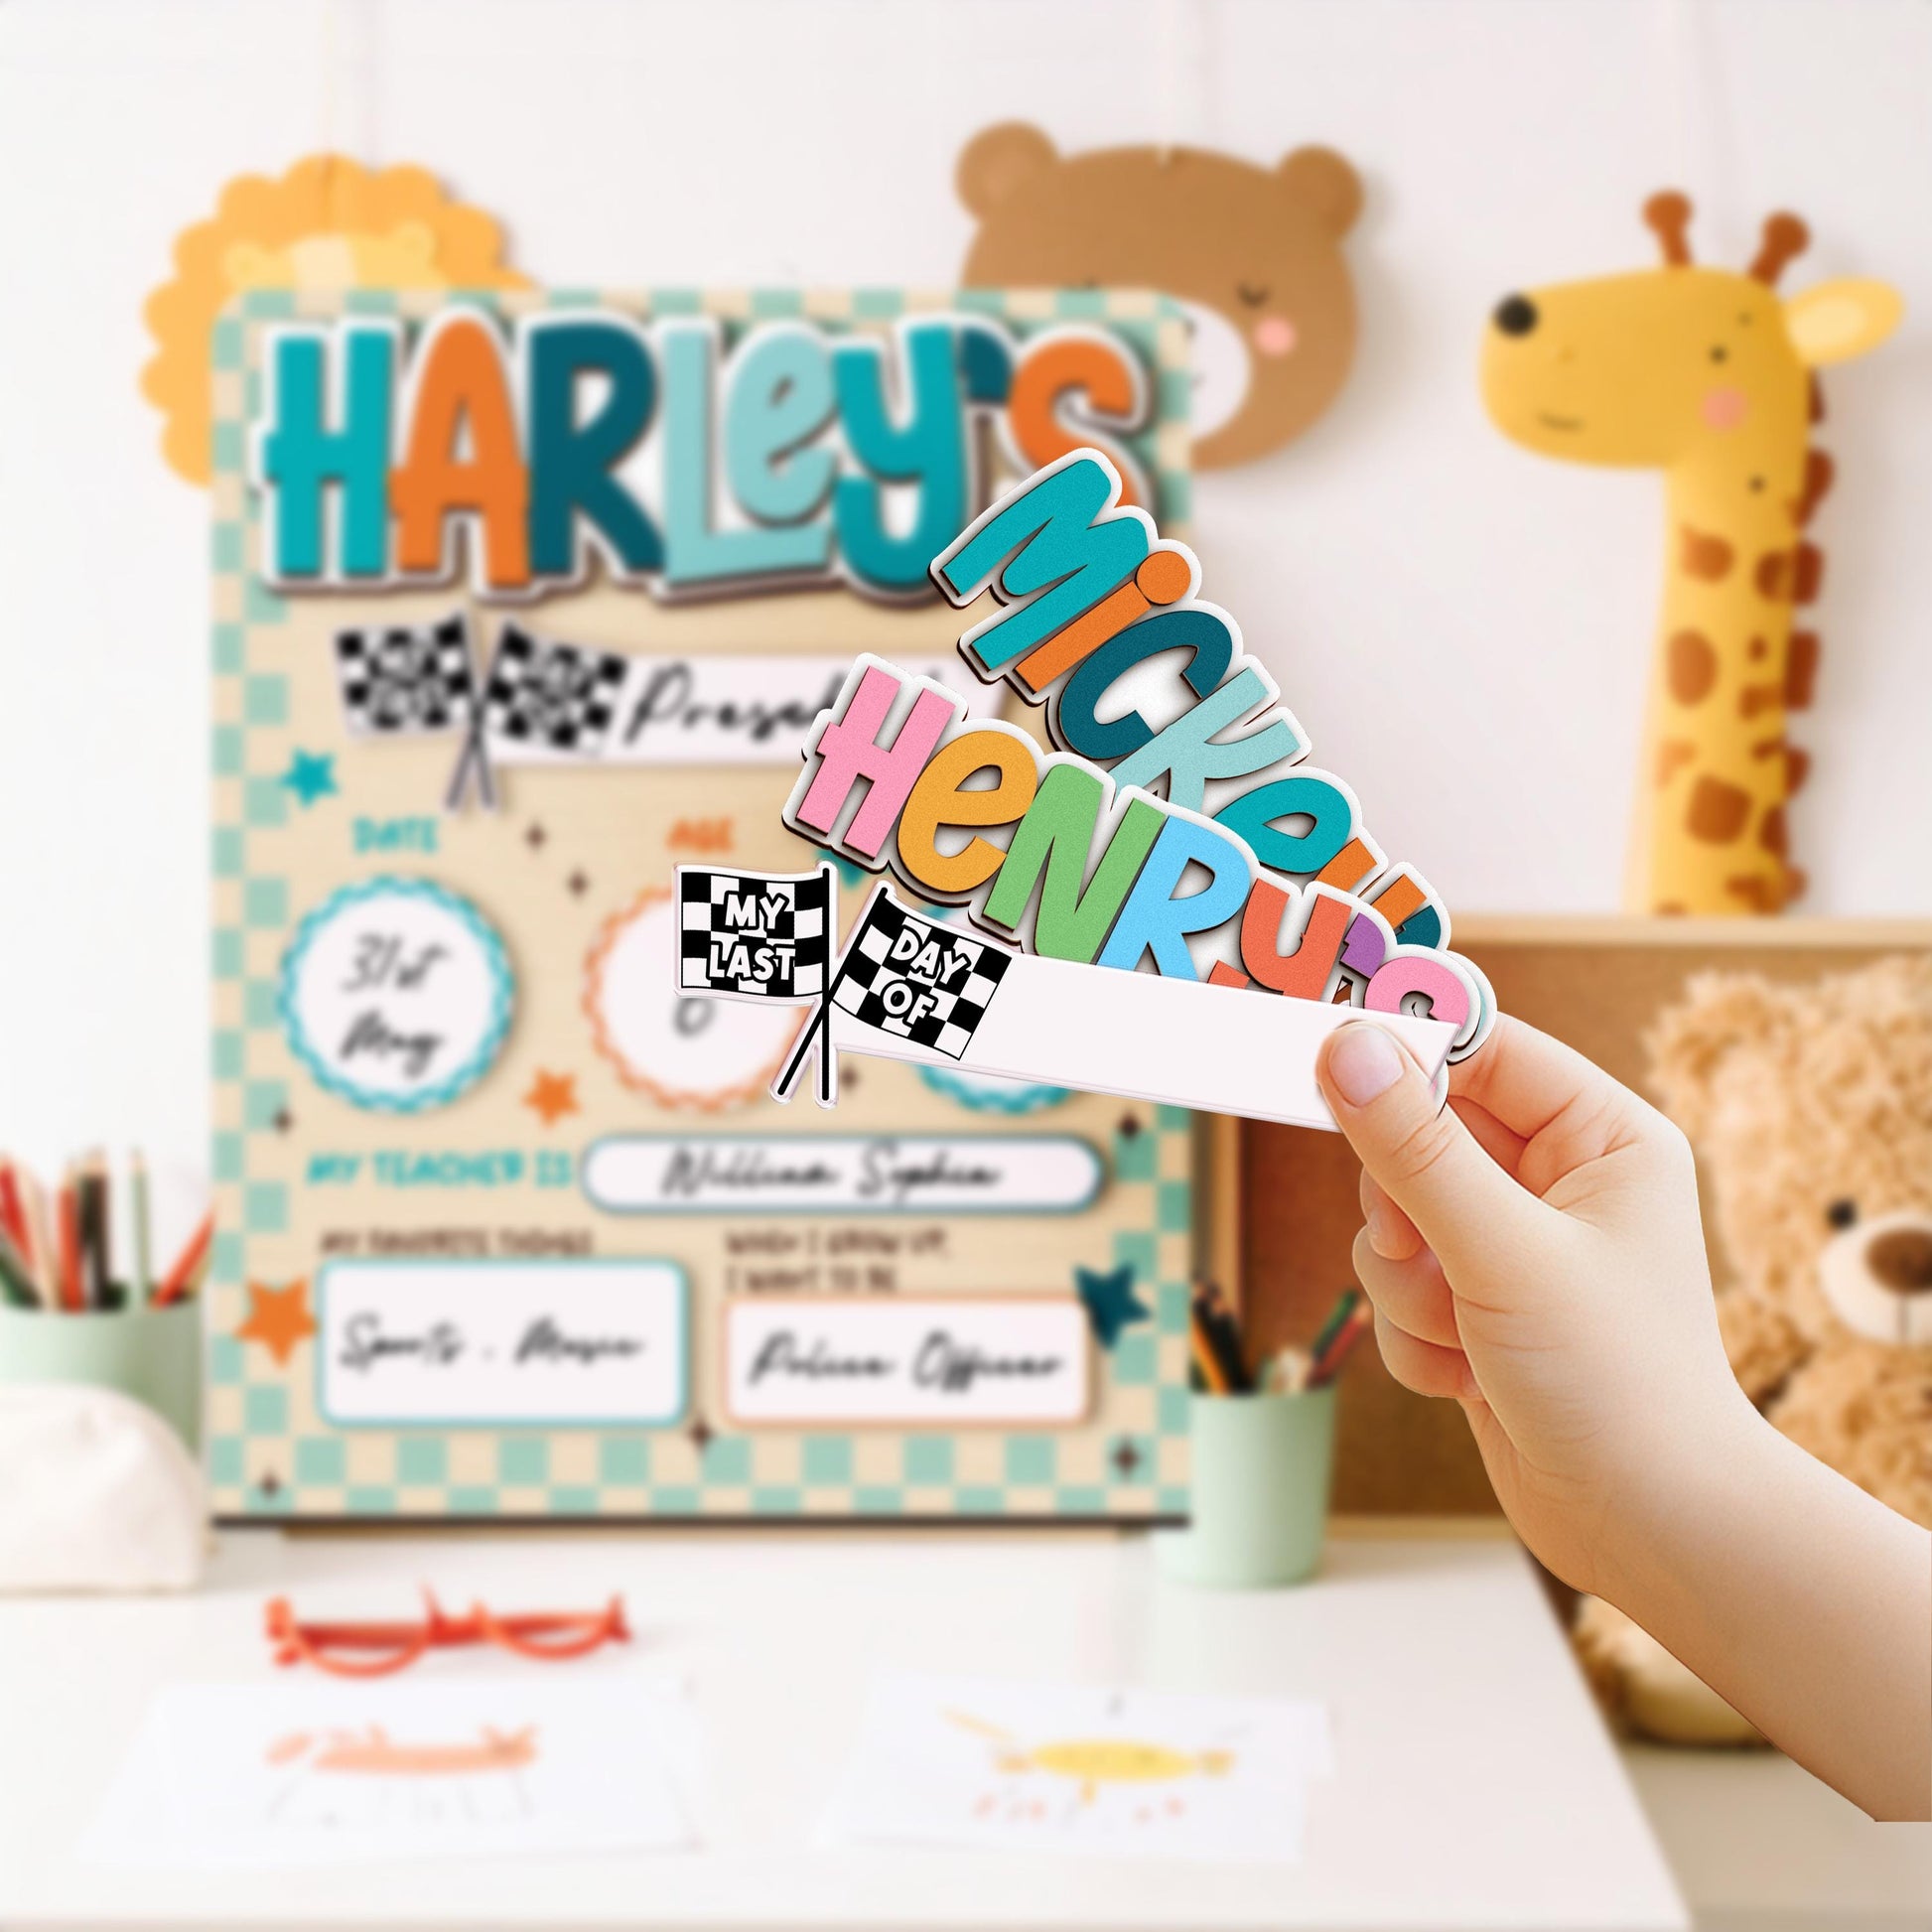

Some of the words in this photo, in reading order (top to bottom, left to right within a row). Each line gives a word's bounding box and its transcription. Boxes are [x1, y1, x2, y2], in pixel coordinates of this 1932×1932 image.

[725, 894, 786, 929] MY
[709, 943, 796, 981] LAST
[890, 927, 969, 985] DAY
[882, 982, 936, 1027] OF
